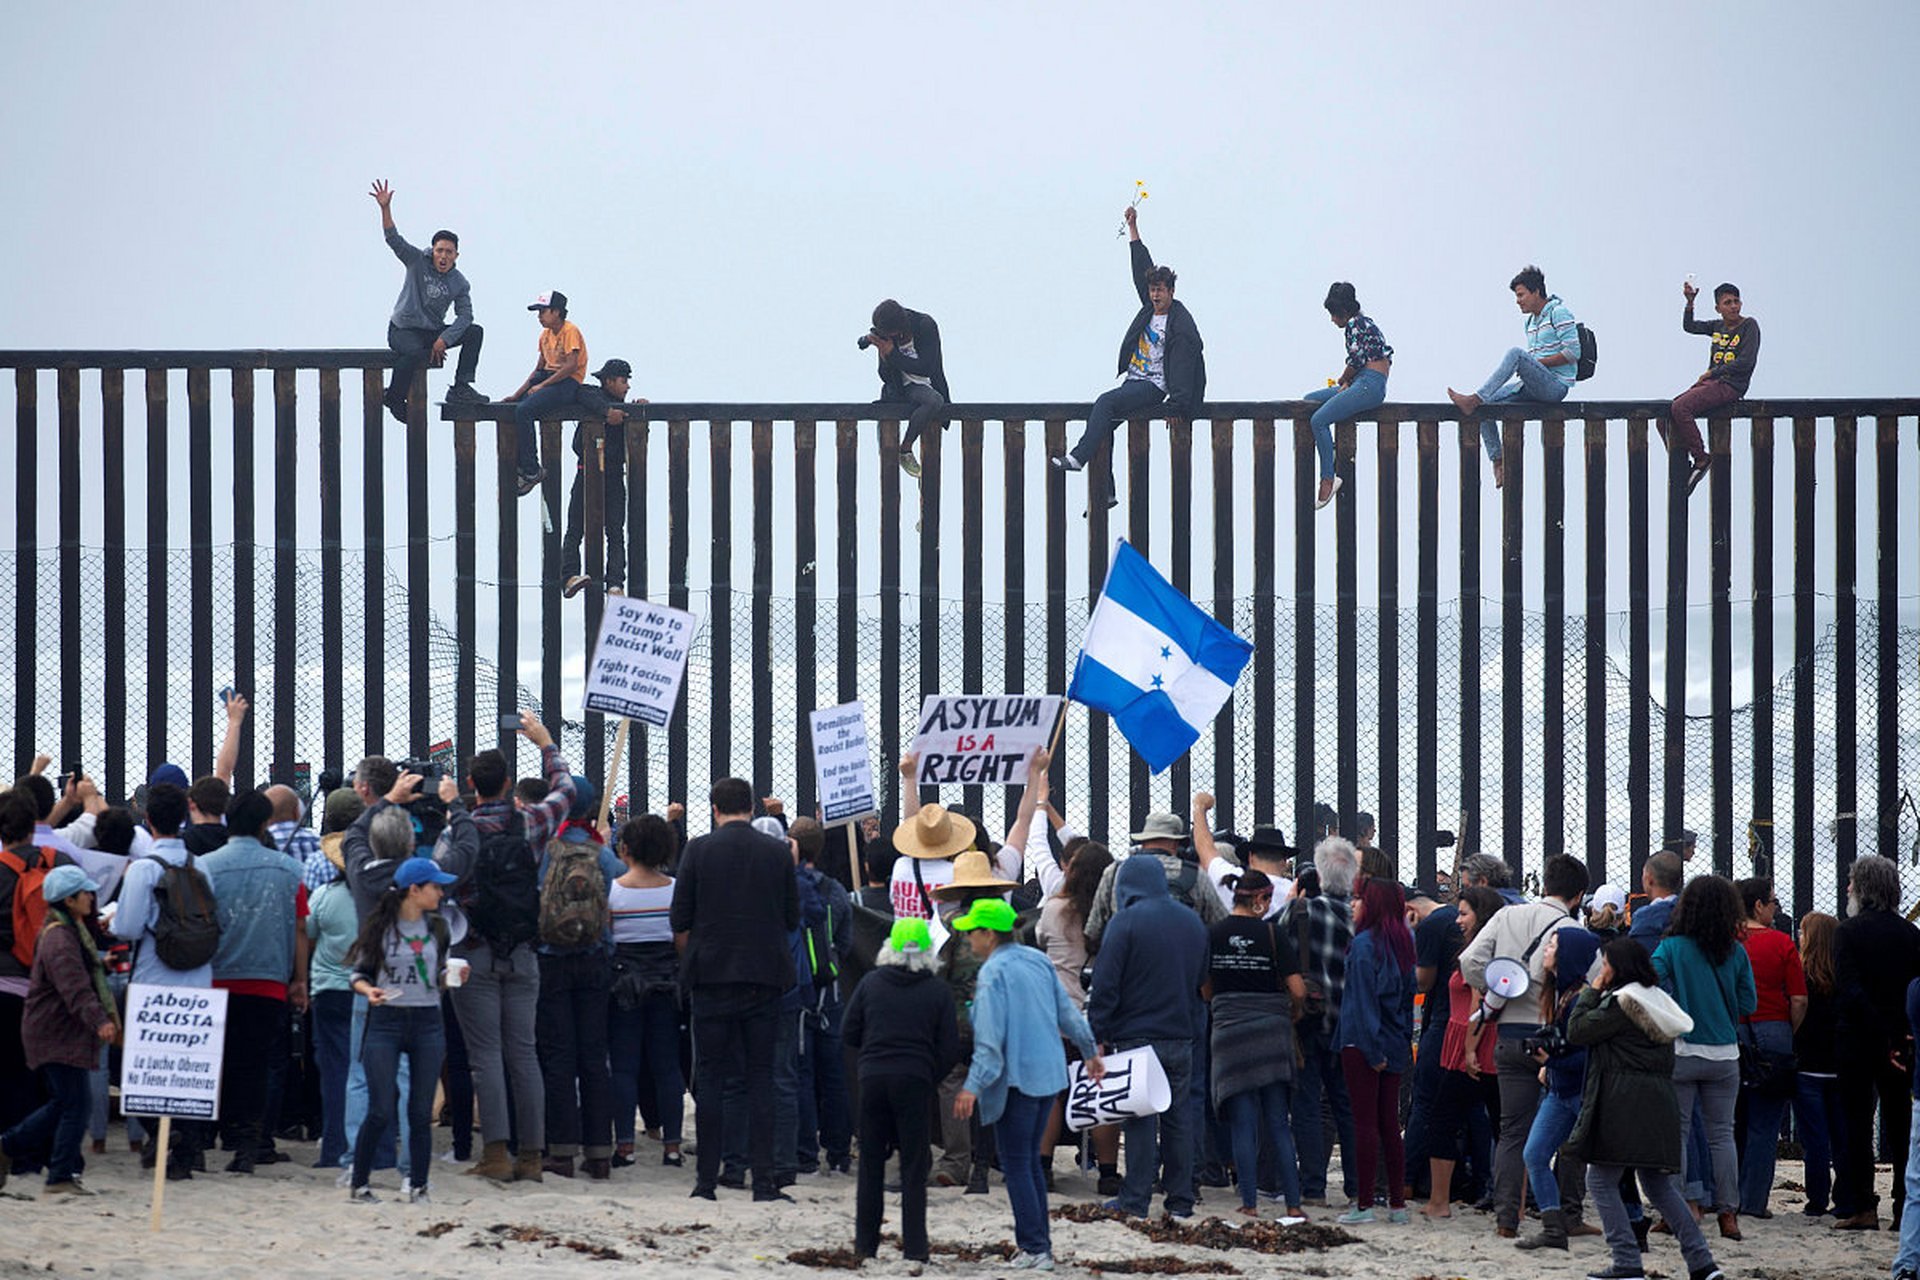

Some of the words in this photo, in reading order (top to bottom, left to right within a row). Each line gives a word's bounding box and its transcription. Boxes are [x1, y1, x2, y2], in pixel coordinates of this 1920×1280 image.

[617, 605, 642, 622] Say
[646, 613, 665, 626] No
[669, 618, 683, 631] to
[619, 621, 675, 644] Trump's
[605, 634, 648, 653] Racist
[651, 643, 684, 662] Wall
[597, 658, 629, 674] Fight
[631, 667, 673, 685] Facism
[600, 674, 629, 689] With
[631, 681, 664, 700] Unity
[919, 698, 1041, 735] ASYLUM
[818, 740, 843, 755] Racist
[956, 734, 977, 752] IS
[980, 733, 995, 751] A
[823, 765, 837, 778] End
[920, 753, 1025, 783] RIGHT
[143, 992, 210, 1011] ¡Abajo
[136, 1011, 214, 1027] RACISTA
[139, 1028, 211, 1047] Trump!
